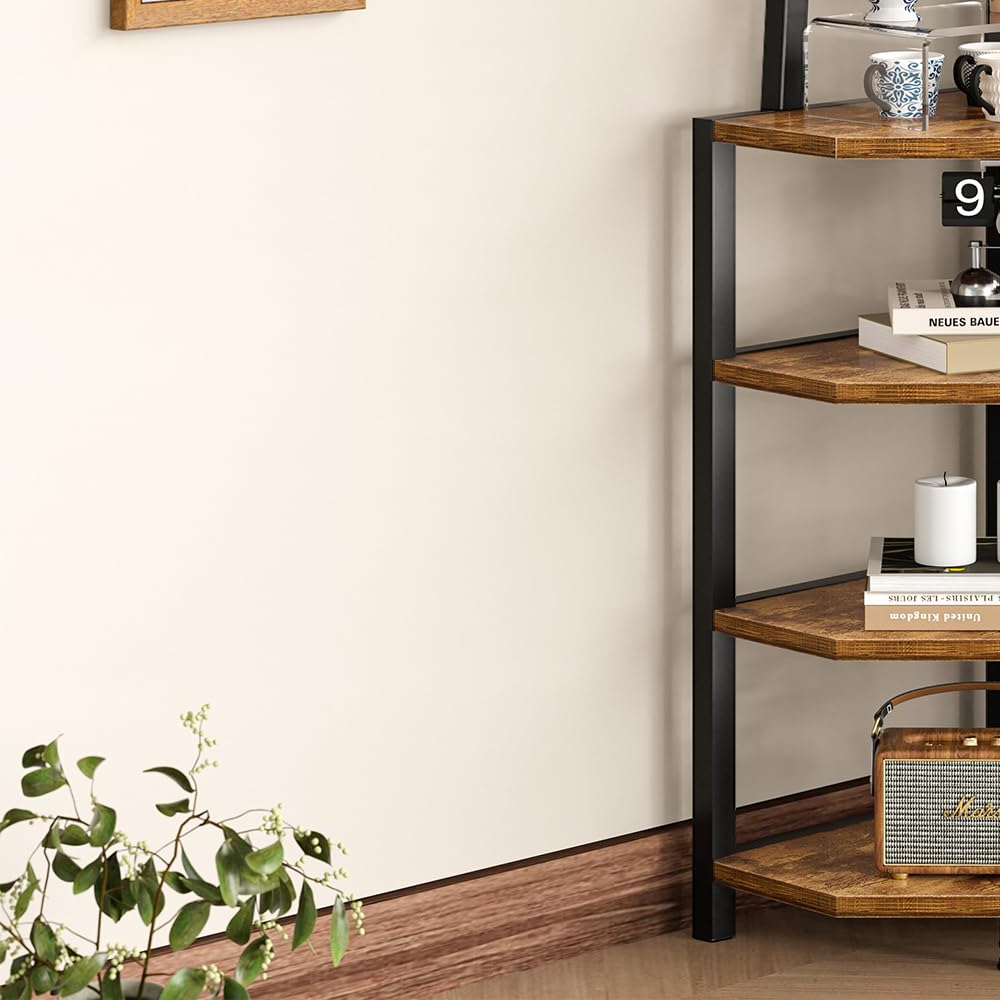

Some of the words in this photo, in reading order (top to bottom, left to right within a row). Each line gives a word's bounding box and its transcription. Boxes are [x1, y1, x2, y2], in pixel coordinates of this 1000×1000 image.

[955, 178, 984, 217] 9
[929, 317, 966, 327] NEUES
[889, 610, 940, 622] Kingdom
[943, 612, 981, 622] United
